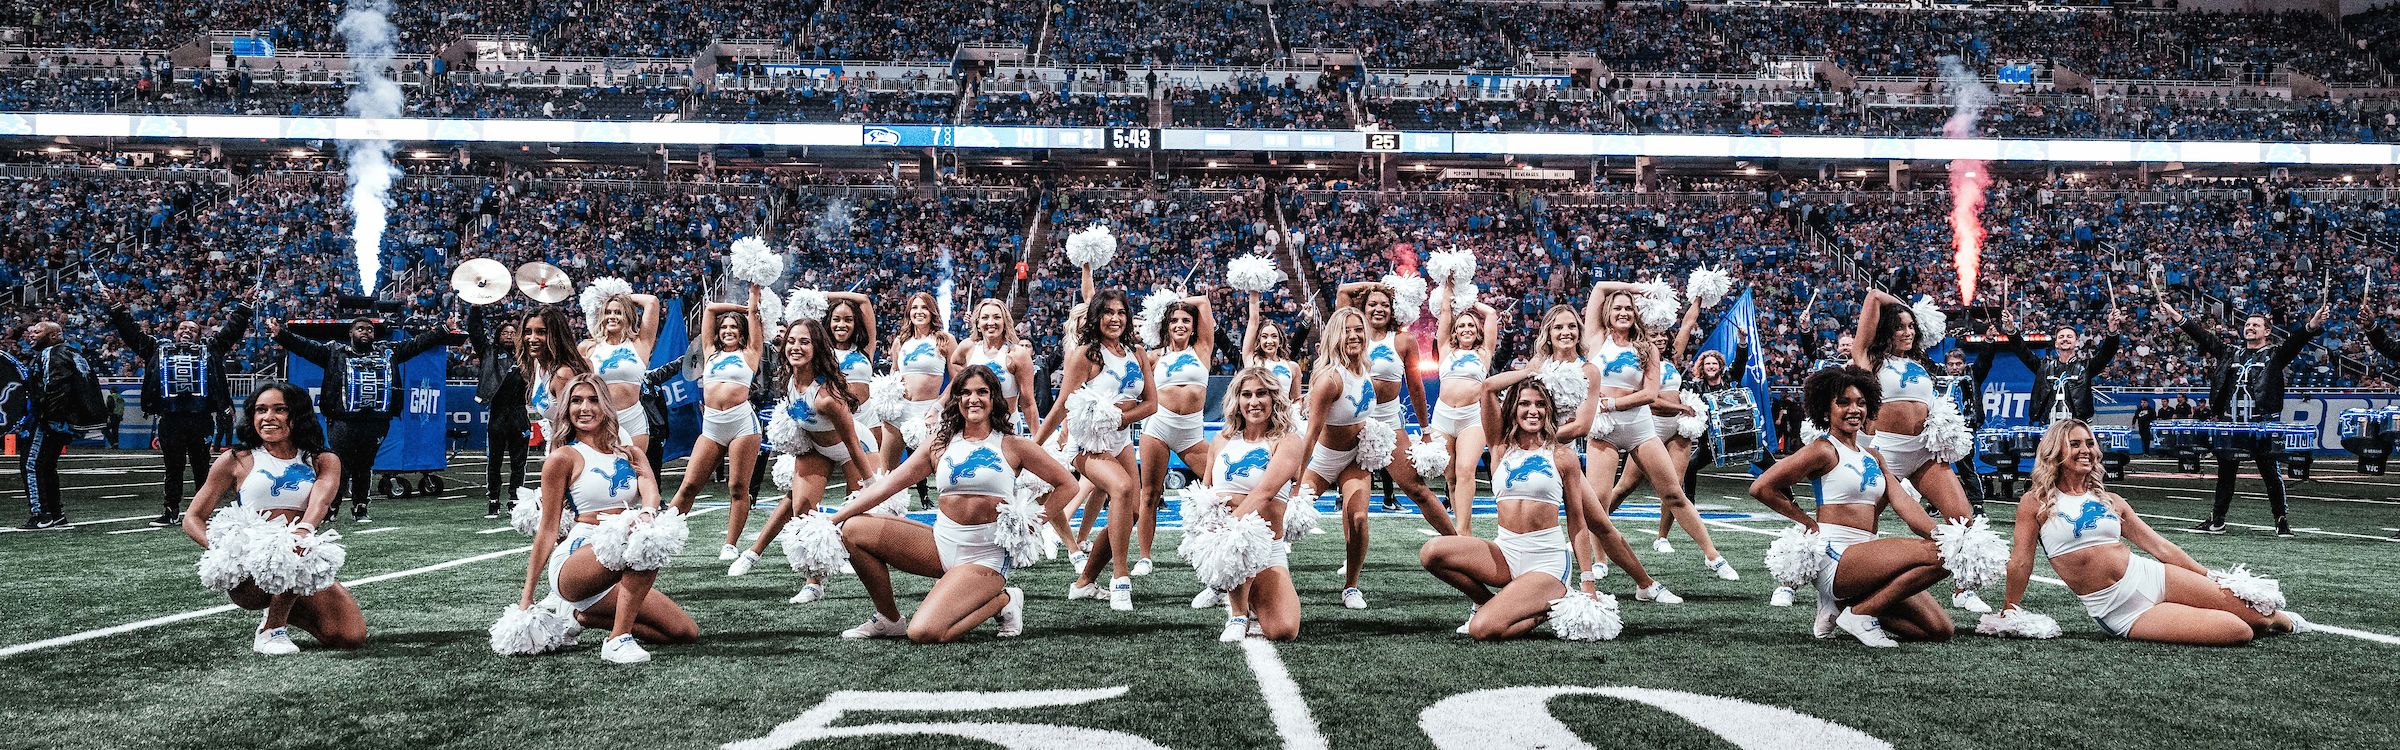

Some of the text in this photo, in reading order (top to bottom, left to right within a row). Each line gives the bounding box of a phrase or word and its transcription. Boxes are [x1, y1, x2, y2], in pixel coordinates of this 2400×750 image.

[1113, 128, 1151, 149] 5:43
[1371, 134, 1395, 150] 25
[409, 387, 441, 415] GRIT
